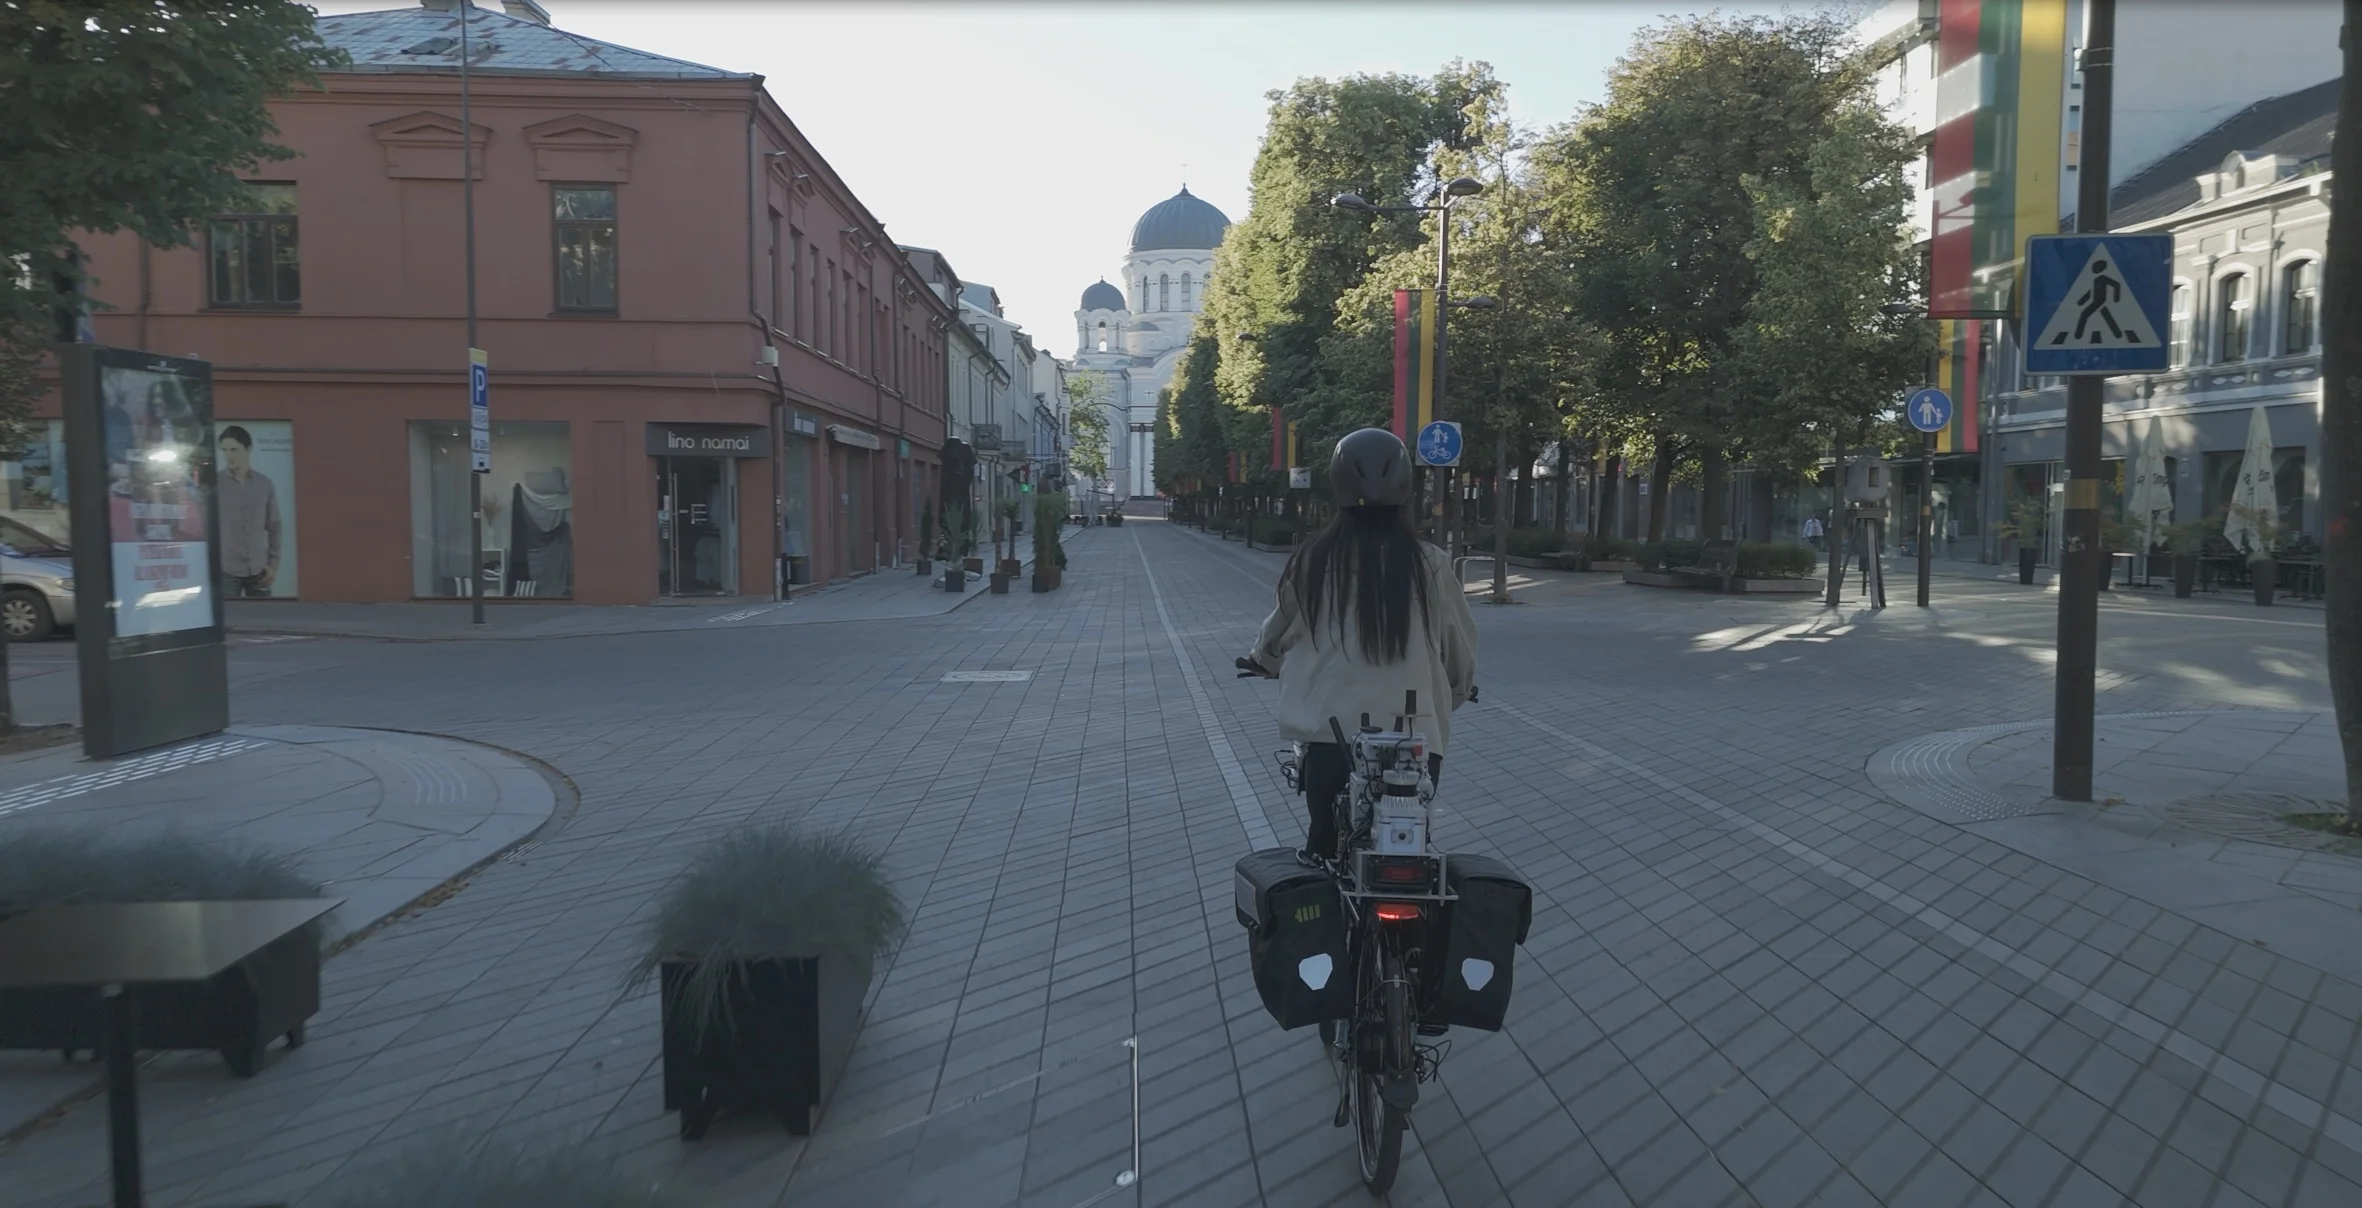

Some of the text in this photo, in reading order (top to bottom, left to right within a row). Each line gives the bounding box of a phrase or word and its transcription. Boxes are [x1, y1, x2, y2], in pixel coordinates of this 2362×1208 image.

[475, 369, 486, 403] P
[667, 430, 750, 451] lino namai
